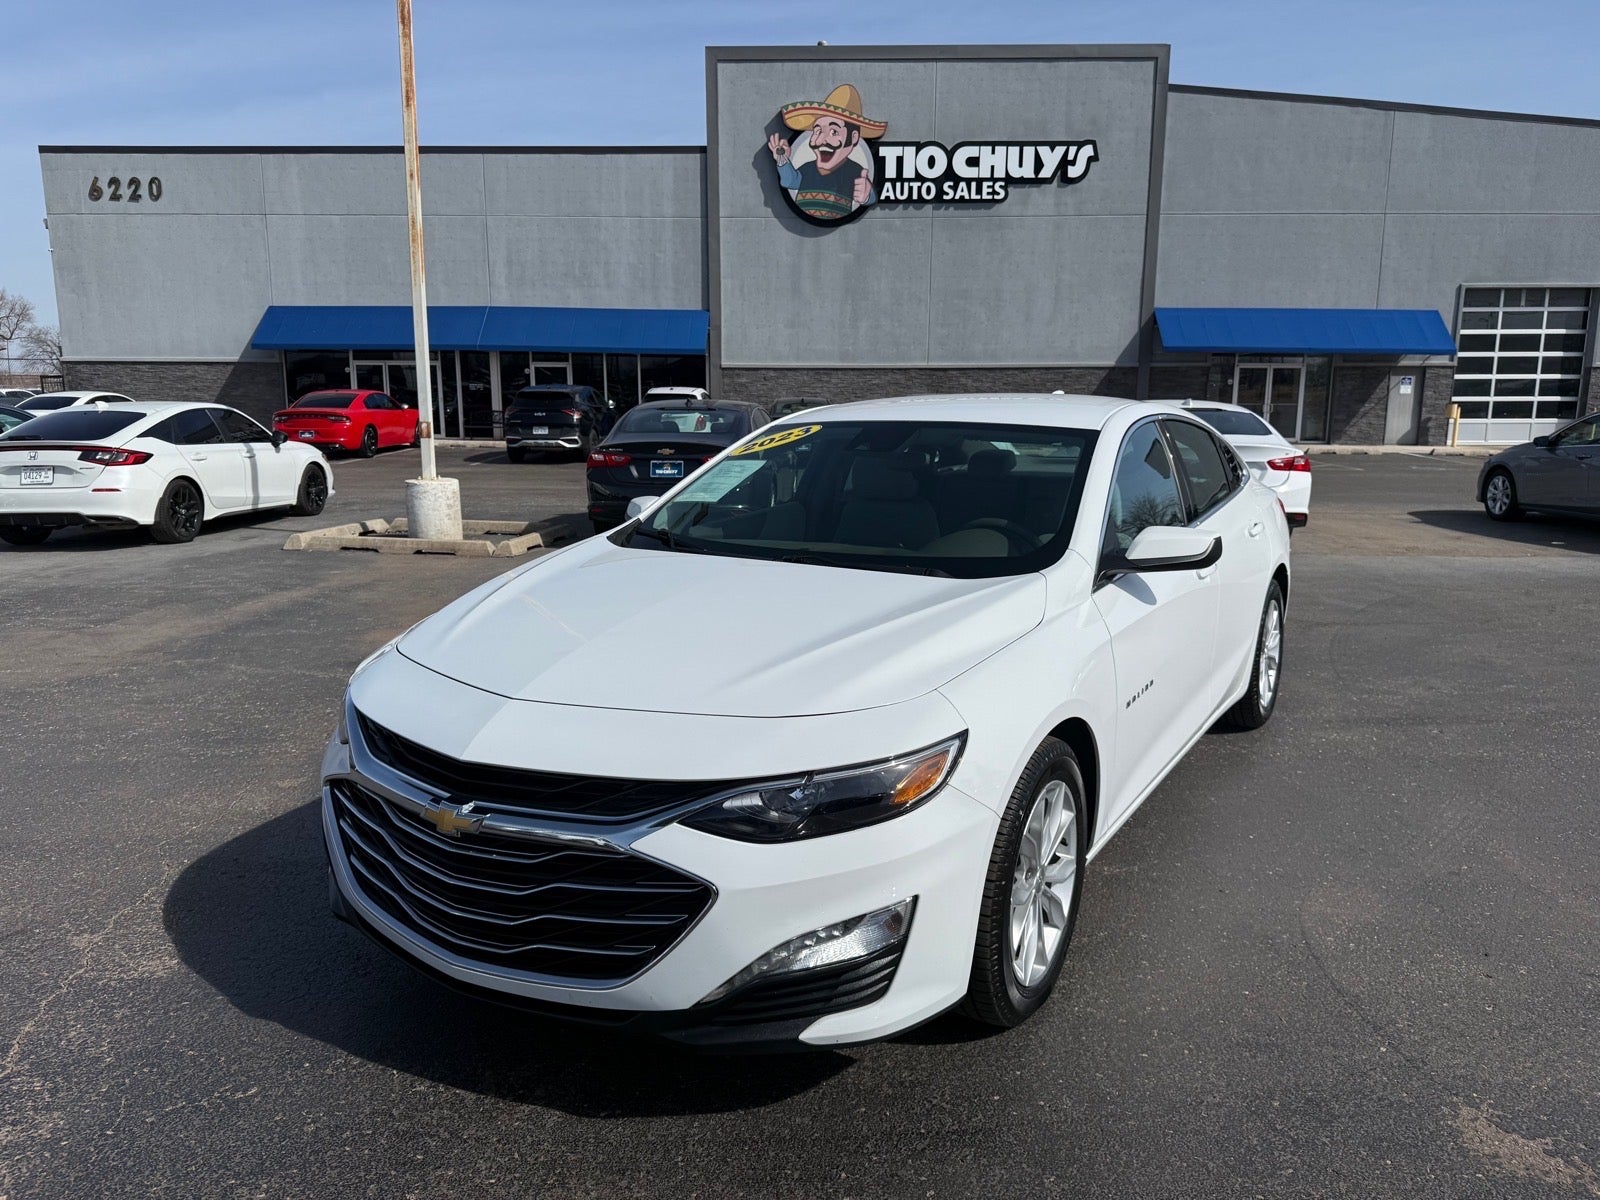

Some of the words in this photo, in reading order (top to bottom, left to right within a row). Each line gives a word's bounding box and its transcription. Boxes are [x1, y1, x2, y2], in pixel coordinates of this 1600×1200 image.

[879, 146, 948, 179] TIO
[951, 144, 1095, 179] CHUY'S
[88, 176, 162, 203] 6220
[880, 181, 937, 200] AUTO
[942, 181, 1006, 200] SALES
[739, 426, 813, 454] 2023
